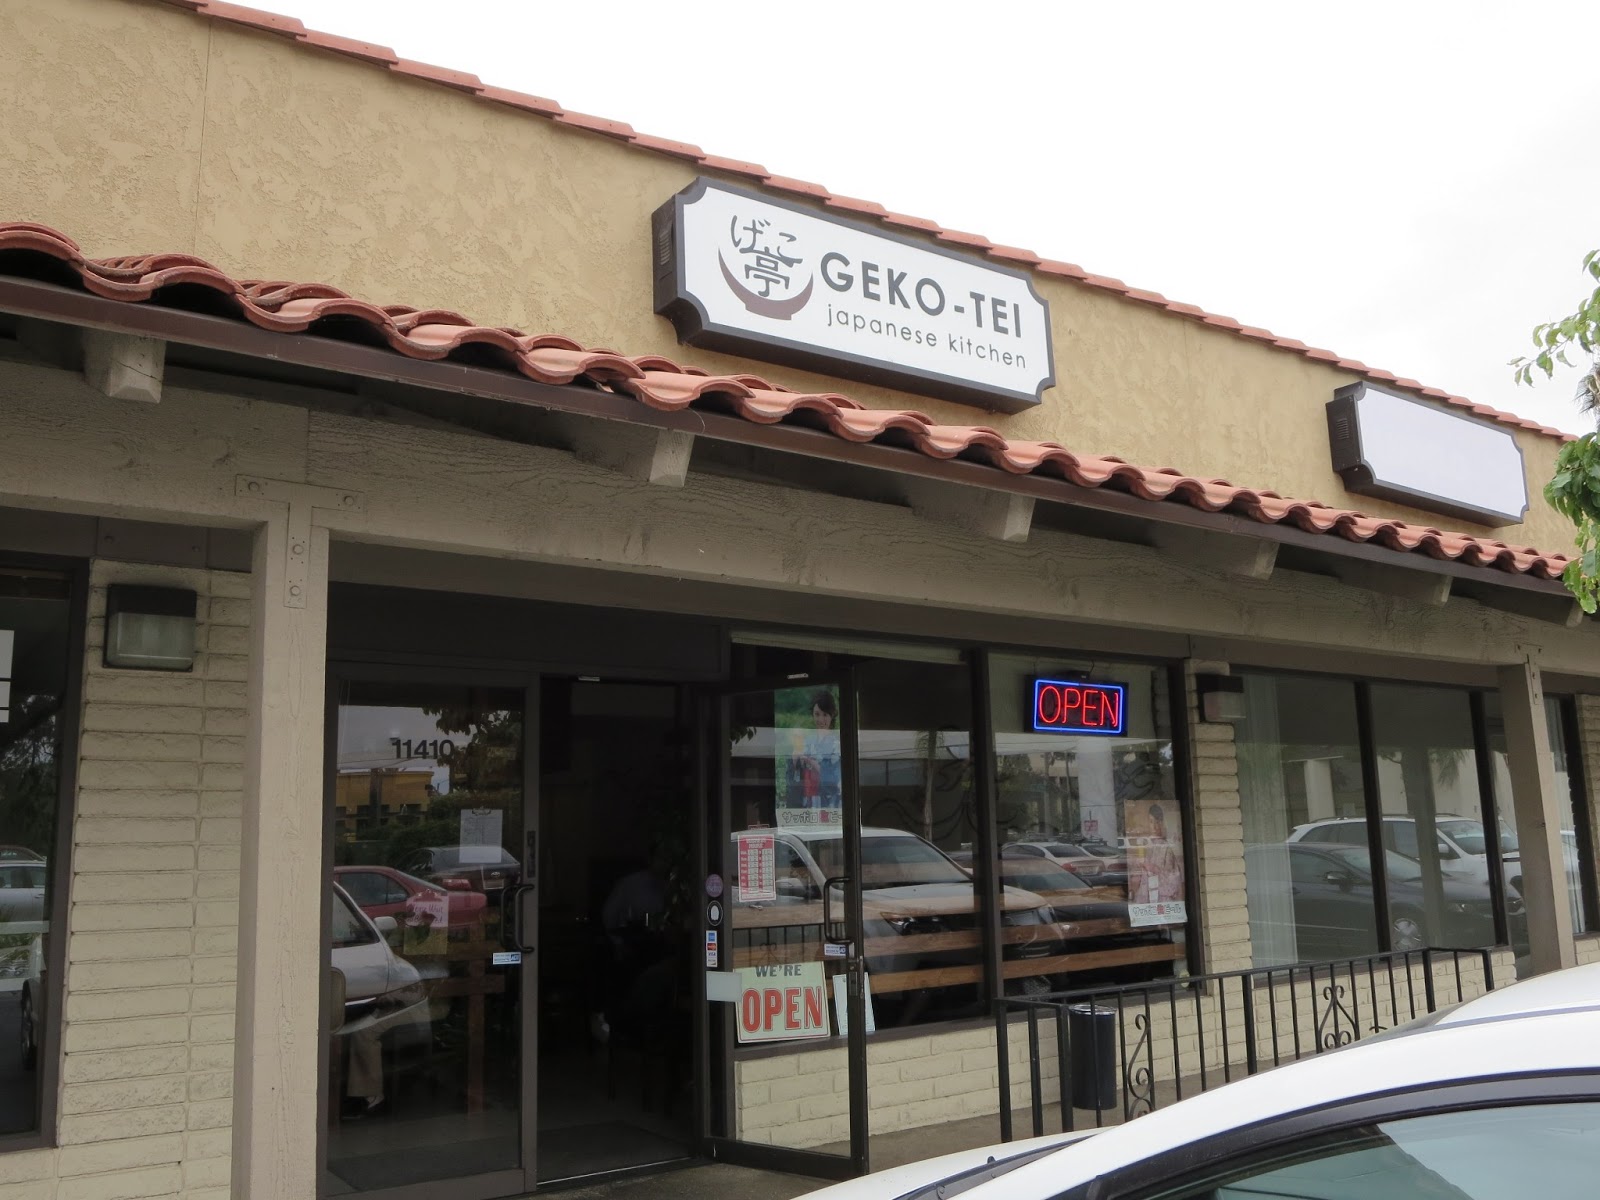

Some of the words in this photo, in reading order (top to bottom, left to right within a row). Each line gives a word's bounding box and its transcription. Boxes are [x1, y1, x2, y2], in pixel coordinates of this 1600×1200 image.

[739, 246, 794, 297] 亭
[820, 252, 1022, 338] GEKO-TEI
[827, 304, 937, 347] japanese
[948, 333, 1027, 369] kitchen
[1038, 685, 1119, 727] OPEN
[391, 739, 454, 759] 11410
[756, 964, 802, 978] WE'RE
[742, 986, 823, 1033] OPEN
